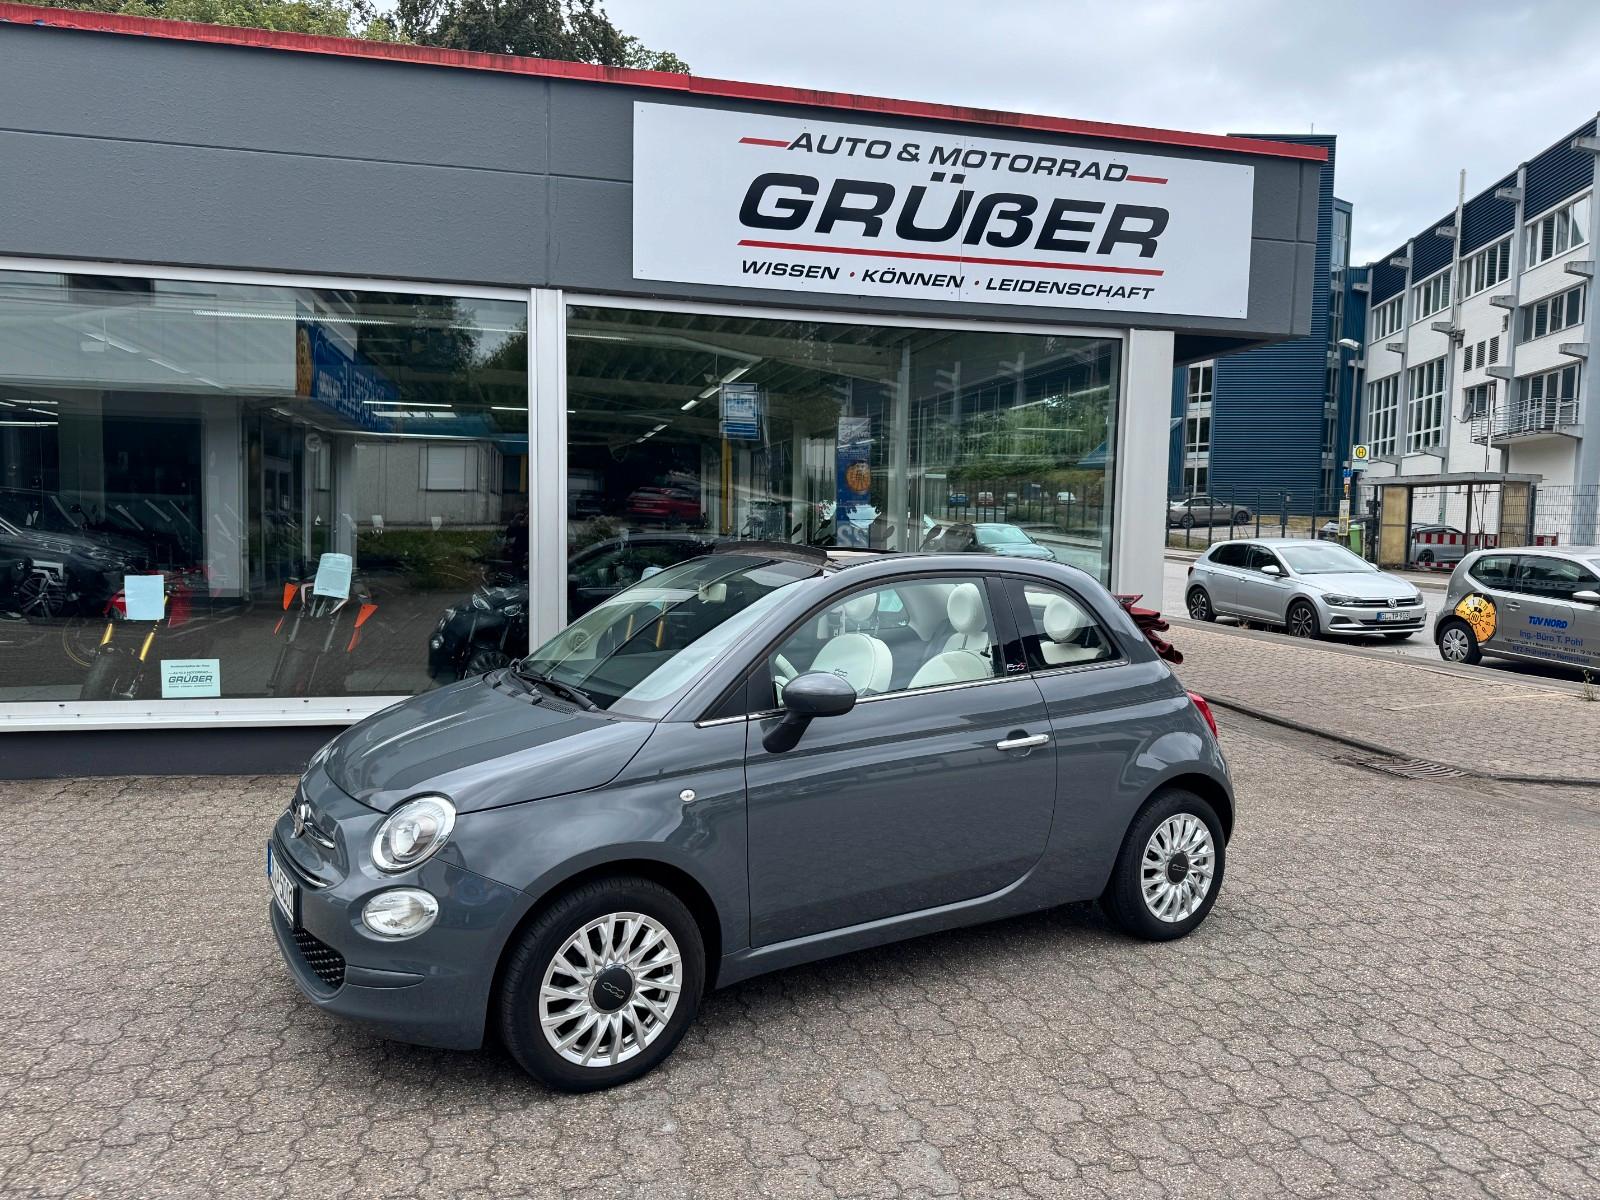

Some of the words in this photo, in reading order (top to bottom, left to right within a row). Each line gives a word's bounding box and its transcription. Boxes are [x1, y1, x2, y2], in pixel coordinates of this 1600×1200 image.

[787, 132, 892, 160] AUTO
[896, 143, 921, 163] &
[928, 145, 1129, 182] MOTORRAD
[741, 260, 840, 280] WISSEN
[861, 267, 965, 288] KÖNNEN
[985, 277, 1156, 301] LEIDENSCHAFT
[1528, 615, 1545, 626] TÜV
[1544, 617, 1568, 629] NORD
